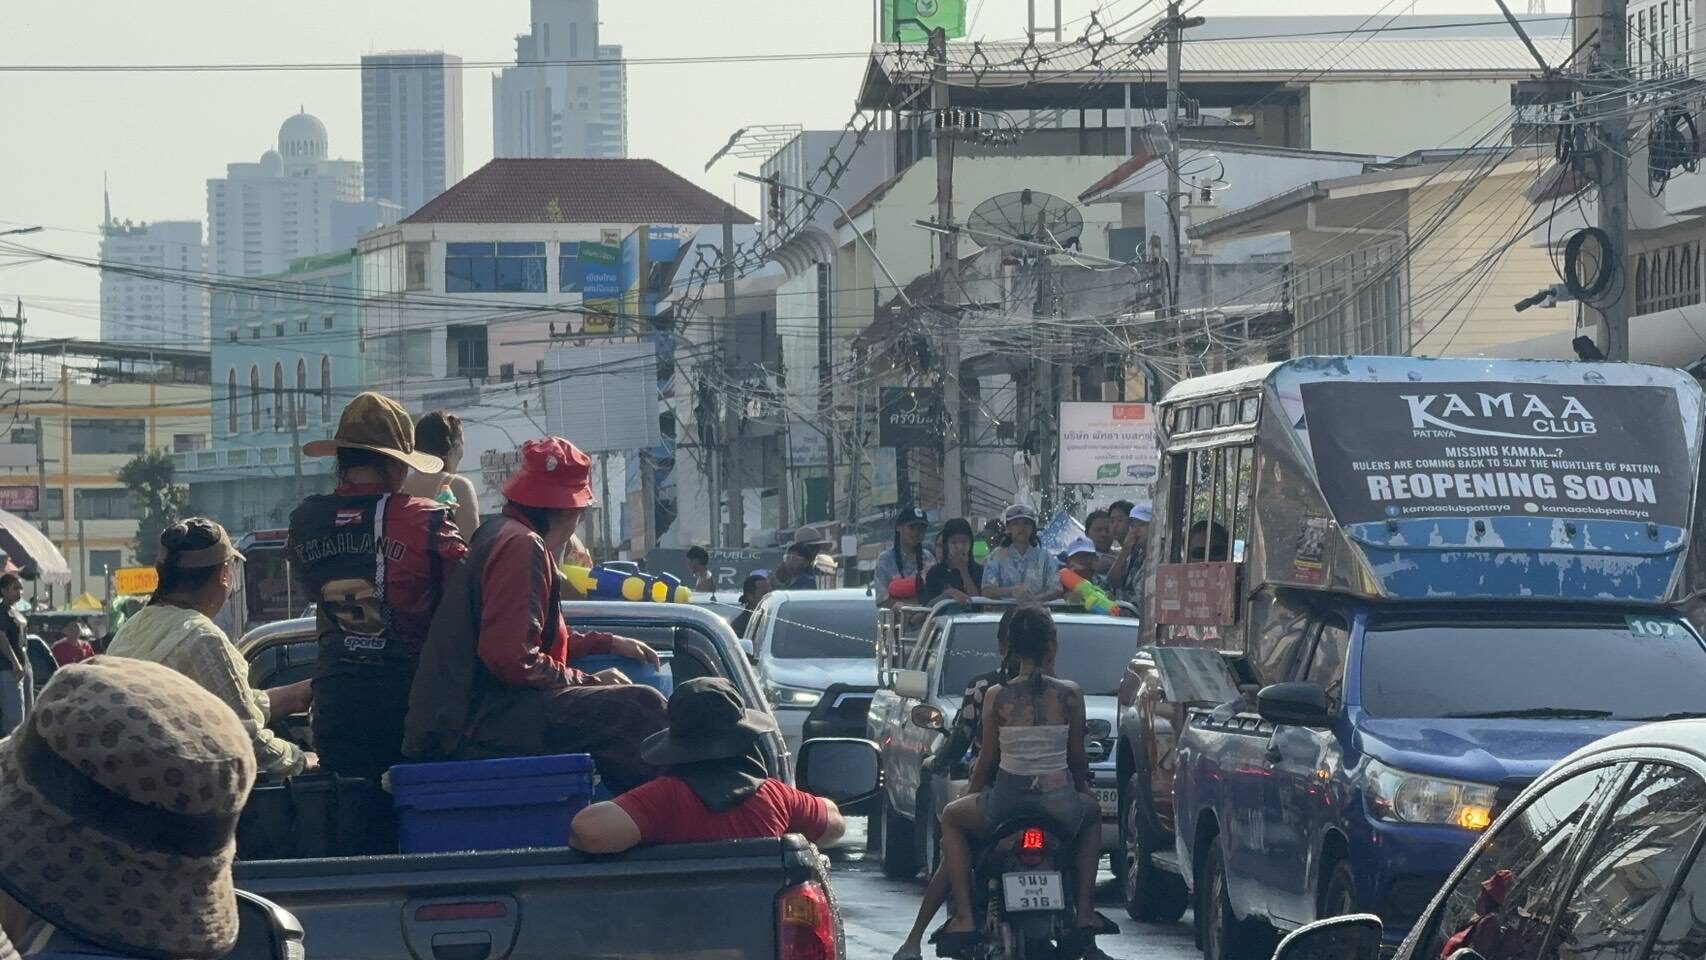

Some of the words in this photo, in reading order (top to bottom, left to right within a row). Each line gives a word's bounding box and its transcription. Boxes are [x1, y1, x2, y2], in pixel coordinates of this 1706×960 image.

[1400, 392, 1594, 429] KAMAA
[1412, 429, 1456, 438] PATTAYA
[1532, 419, 1597, 434] CLUB
[1445, 446, 1499, 458] MISSING
[1352, 461, 1391, 471] RULERS
[1394, 459, 1413, 469] ARE
[1415, 459, 1456, 469] COMING
[1458, 459, 1485, 469] BACK
[1487, 458, 1500, 467] TO
[1502, 459, 1526, 468] SLAY
[1530, 459, 1549, 469] THE
[1551, 460, 1602, 471] NIGHTLIFE
[1605, 462, 1617, 472] OF
[1619, 463, 1661, 475] PATTAYA
[1366, 472, 1558, 501] REOPENING
[1562, 474, 1657, 504] SOON
[1402, 504, 1511, 514] kamaaclubpattaya
[1542, 504, 1649, 518] kamaaclubpattaya
[295, 533, 407, 562] THAILAND
[704, 550, 761, 560] EPUBLIC
[718, 566, 737, 585] R
[1631, 620, 1675, 636] 107
[344, 635, 386, 651] sports
[1020, 896, 1050, 908] 316
